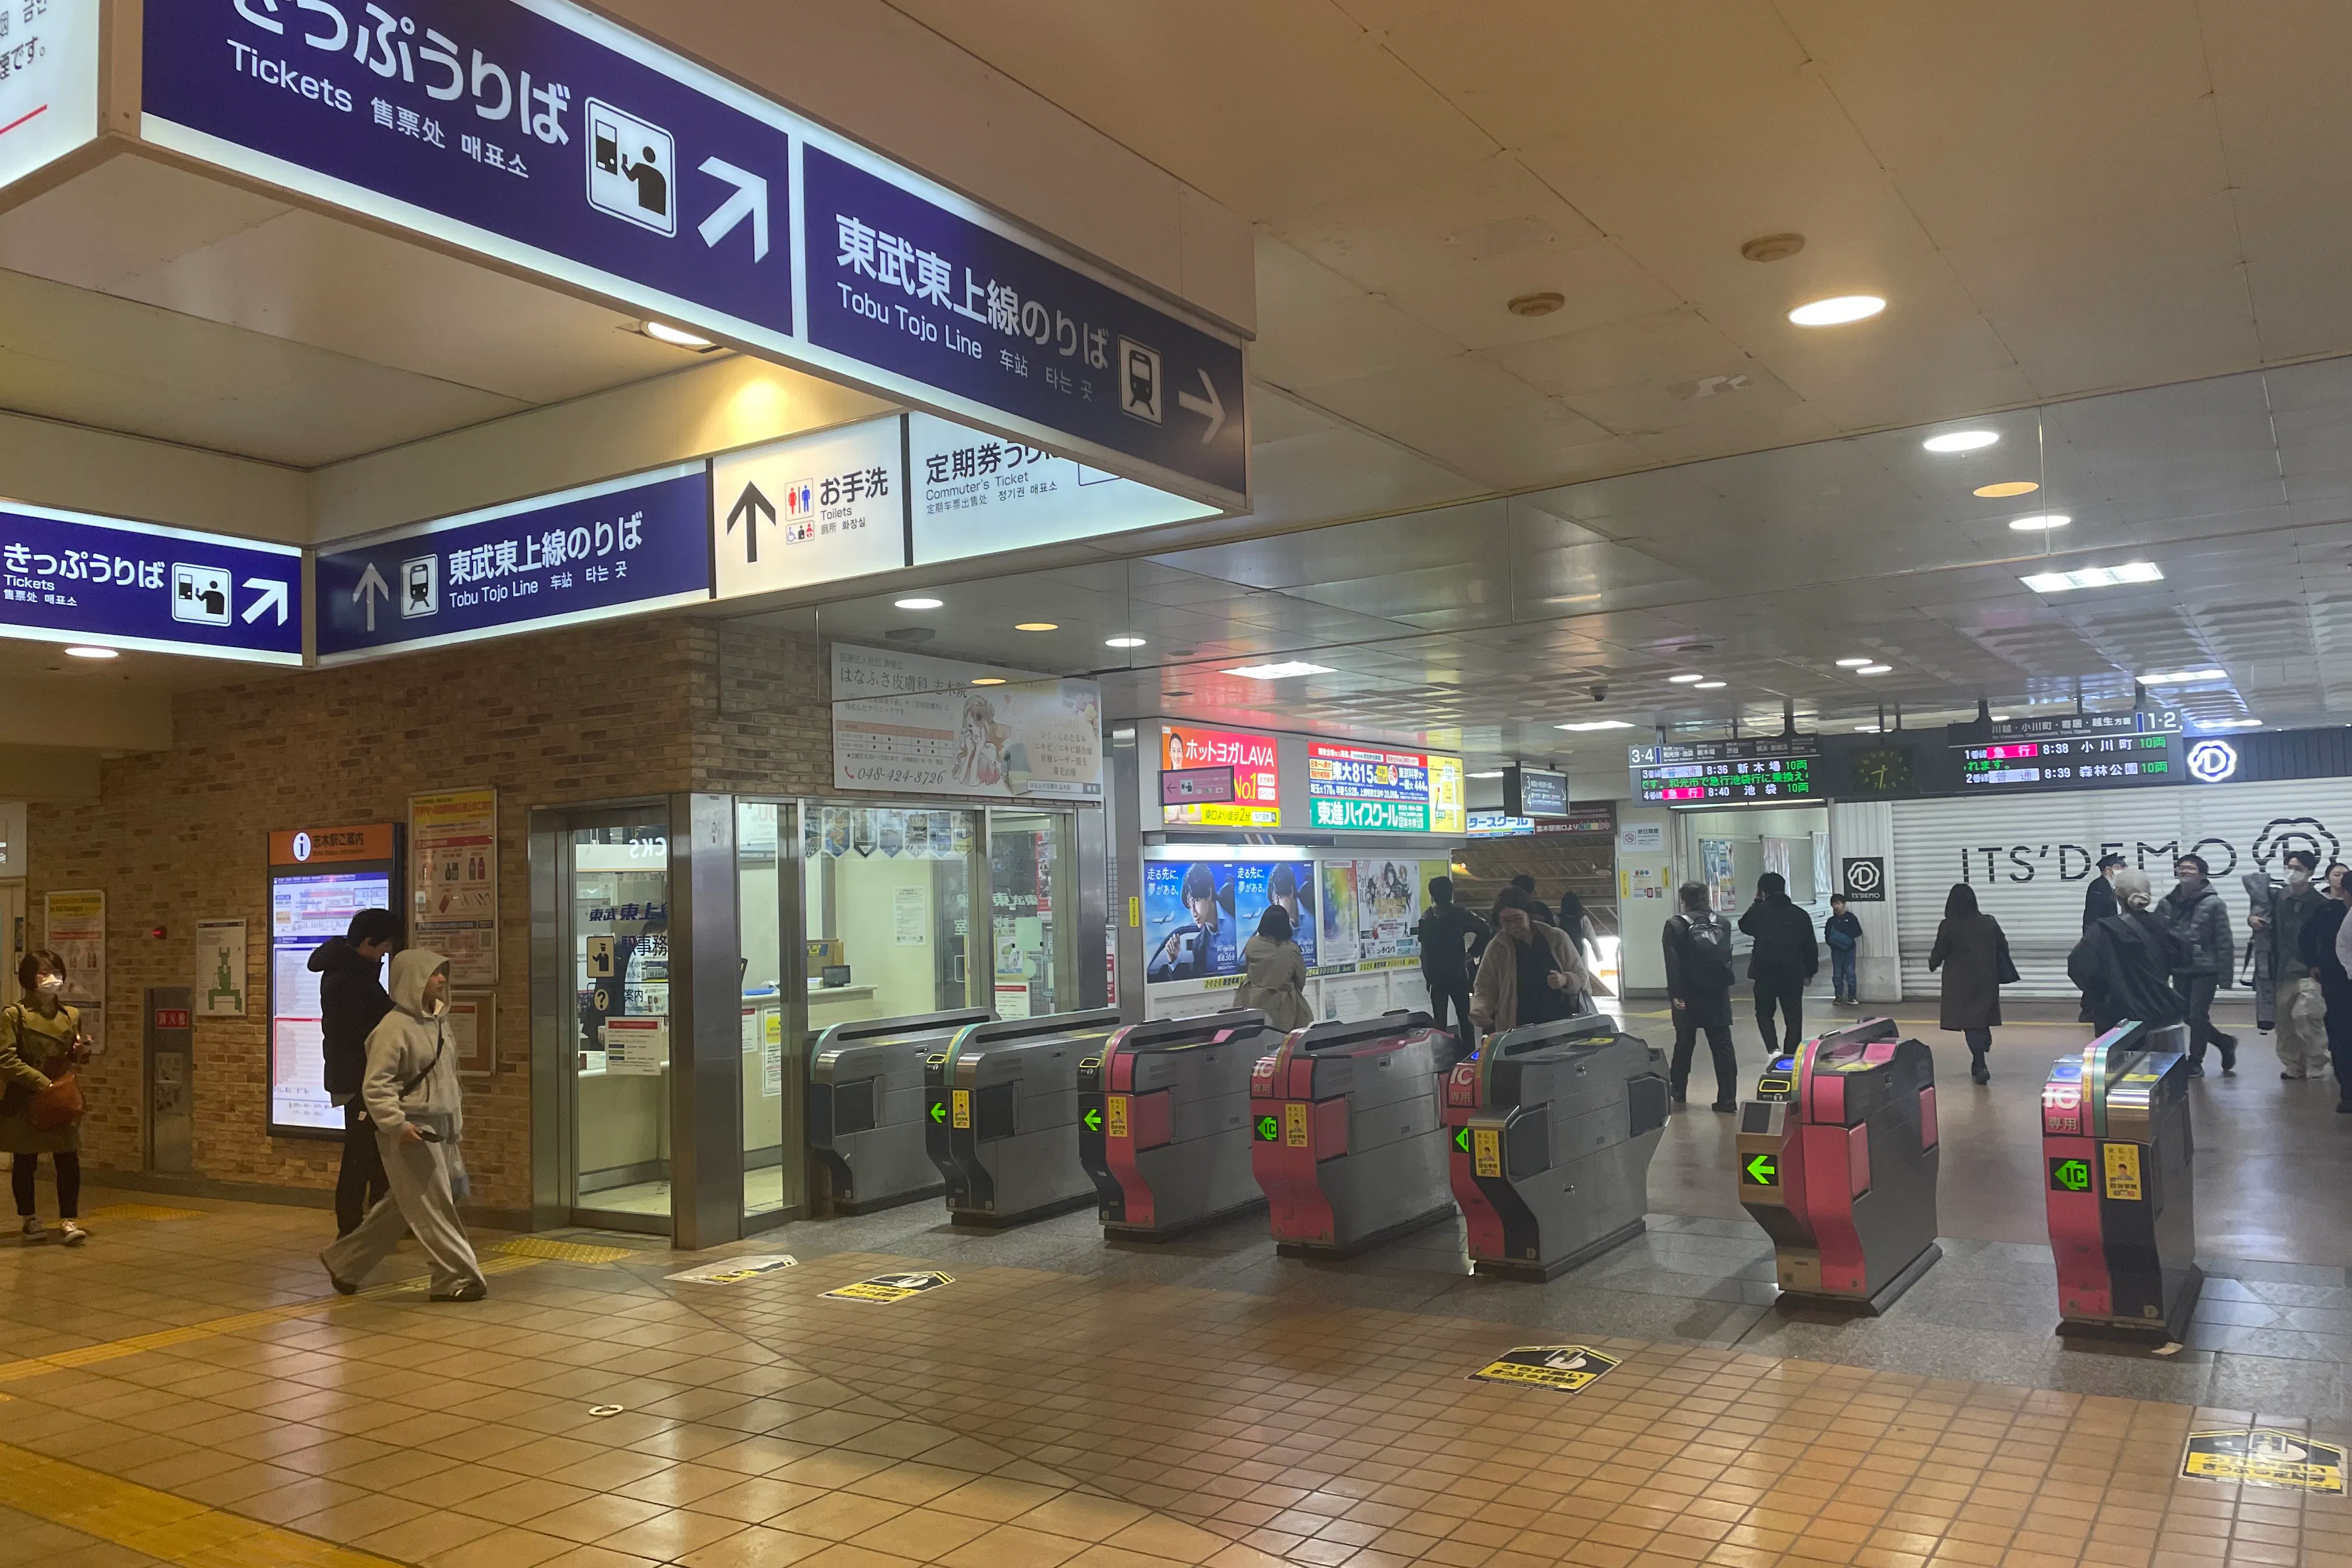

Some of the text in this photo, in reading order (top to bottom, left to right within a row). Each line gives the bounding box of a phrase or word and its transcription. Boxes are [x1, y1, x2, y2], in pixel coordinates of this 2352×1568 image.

[226, 38, 353, 113] Tickets
[371, 96, 529, 178] 售票处 매표소
[835, 213, 1110, 370] 東武東上線のりば
[836, 281, 890, 325] Tobu
[893, 304, 938, 343] Tojo
[944, 328, 983, 360] Line
[999, 349, 1029, 379] 车站
[819, 466, 889, 506] お手洗
[926, 471, 1029, 502] Commuter's Ticket
[998, 487, 1026, 502] 정기권
[1030, 480, 1058, 495] 매표소
[820, 506, 852, 522] Toilets
[842, 516, 866, 531] 화장실
[449, 510, 643, 586] 東武東上線のりば
[3, 542, 167, 590] きっぷうりば
[3, 574, 55, 591] Tickets
[449, 591, 479, 608] Tobu
[482, 585, 509, 603] Tojo
[512, 579, 539, 597] Line
[550, 571, 573, 590] 车站
[585, 565, 609, 584] 타는
[841, 667, 928, 691] はなふさ皮膚科
[1185, 738, 1275, 768] ホットヨガLAVA
[2042, 743, 2070, 755] 8:38
[2080, 738, 2133, 753] 小川町
[2139, 736, 2166, 749] 10両
[1666, 767, 1697, 778] 普通
[1706, 764, 1728, 775] 8:36
[1737, 761, 1782, 774] 新木場
[1786, 760, 1807, 771] 10両
[1994, 769, 2032, 782] 普通
[2044, 767, 2071, 779] 8:39
[2079, 762, 2138, 778] 森林公園
[2141, 761, 2169, 774] 10両
[1234, 772, 1257, 800] No.1
[1526, 775, 1531, 789] 3
[1642, 771, 1809, 790] です。和光市で急行池袋行に乗換え
[1708, 786, 1730, 797] 8:40
[1744, 783, 1777, 796] 池袋
[1787, 782, 1809, 793] 10両
[1527, 797, 1532, 808] 4
[1205, 807, 1251, 822] 東口より徒歩2分
[1317, 800, 1398, 828] 東進ハイスクール
[1468, 817, 1529, 828] タースクール
[1962, 838, 2238, 884] ITS'DMO
[1147, 866, 1180, 880] 走る先に、
[1237, 866, 1265, 879] 走る先に、
[1147, 882, 1180, 897] 夢がある。
[1238, 880, 1266, 893] 夢がある。
[1252, 1060, 1274, 1077] IC
[1450, 1067, 1475, 1085] IC
[1451, 1091, 1471, 1102] 専用
[1264, 1121, 1276, 1135] IC
[2048, 1116, 2078, 1130] 専用
[2066, 1167, 2085, 1183] IC
